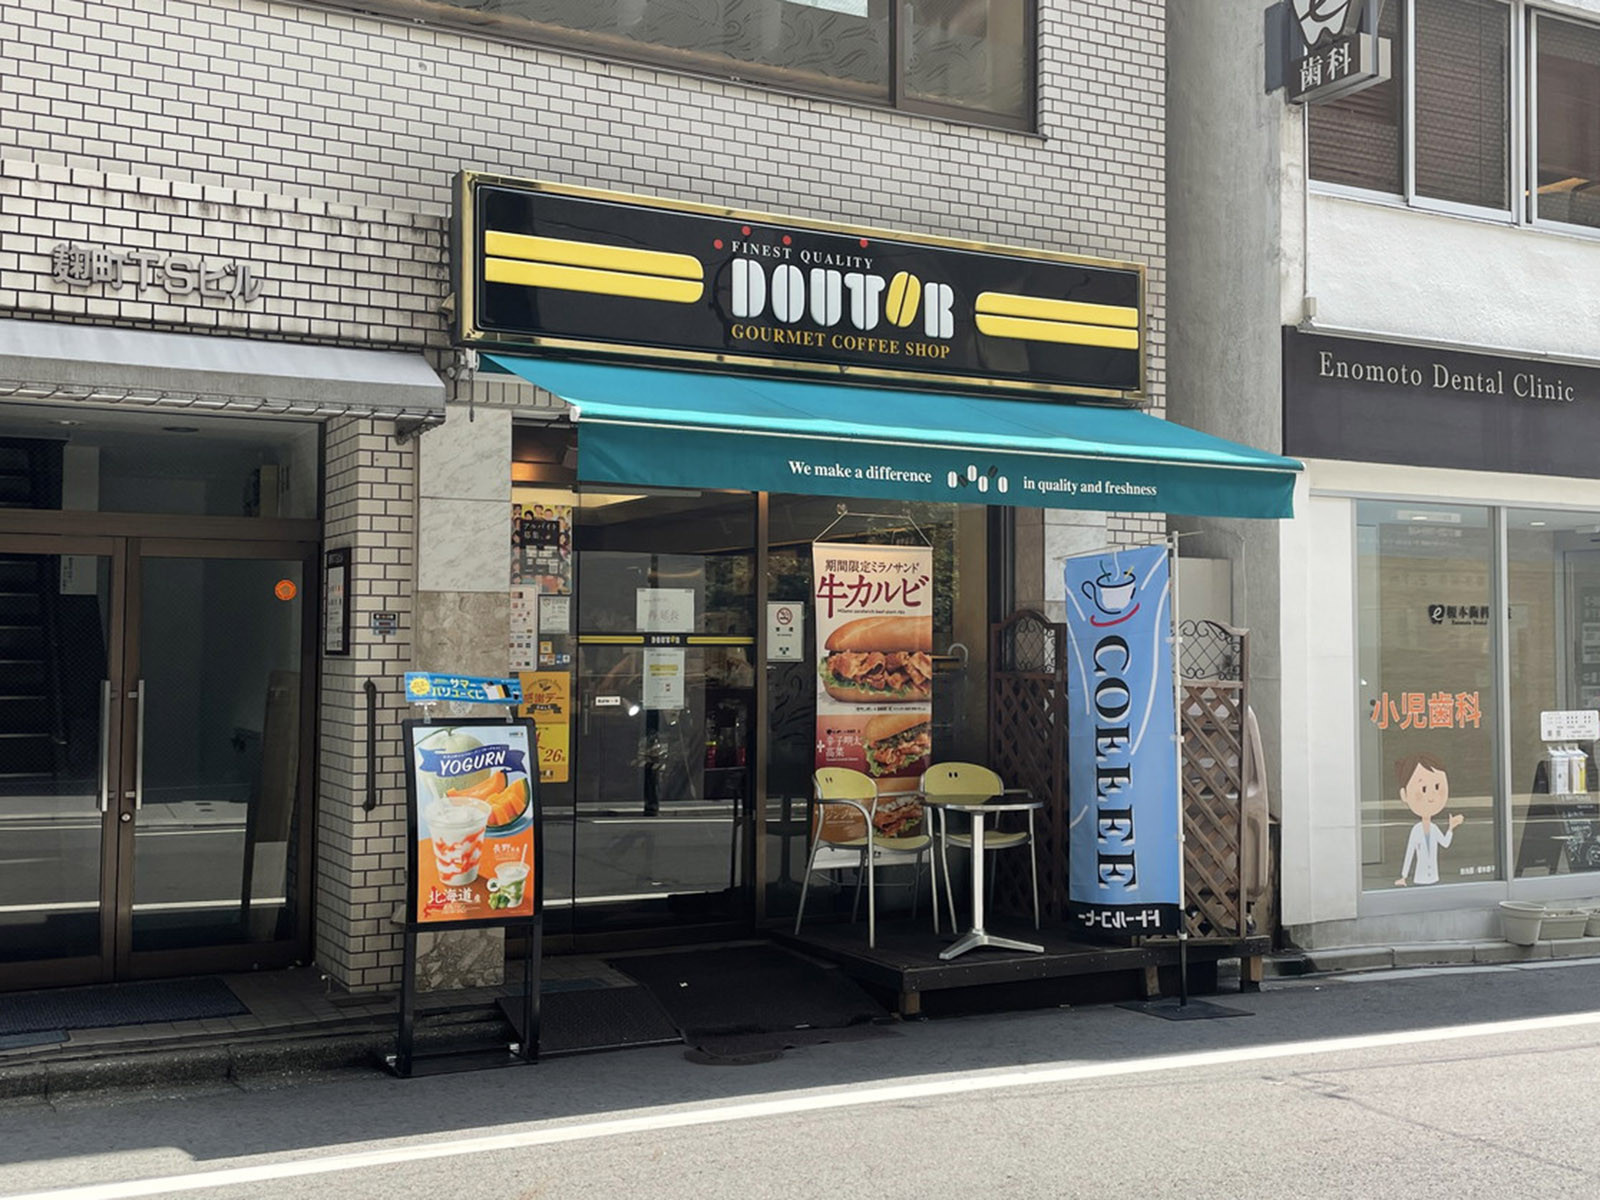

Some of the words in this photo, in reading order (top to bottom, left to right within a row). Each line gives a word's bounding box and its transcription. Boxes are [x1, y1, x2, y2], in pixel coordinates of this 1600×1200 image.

[1300, 42, 1352, 91] 歯科
[731, 240, 792, 260] FINEST
[800, 250, 873, 269] QUALITY
[731, 258, 955, 339] DOUTOR
[731, 324, 826, 348] GOURMET
[831, 334, 900, 354] COFFEE
[905, 342, 950, 359] SHOP
[1319, 351, 1423, 386] Enomoto
[1433, 363, 1504, 395] Dental
[1513, 373, 1575, 402] Clinic
[788, 460, 812, 476] We
[814, 464, 853, 479] make
[855, 470, 863, 479] a
[865, 467, 932, 483] difference
[1023, 476, 1037, 490] in
[1038, 478, 1077, 495] quality
[1080, 480, 1102, 493] and
[1105, 481, 1157, 496] freshness
[825, 559, 920, 574] 期間限定ミラノサンド
[816, 573, 930, 618] 牛カルビ
[450, 678, 477, 688] サマー
[1370, 691, 1482, 729] 小児歯科
[440, 750, 506, 776] YOGURN
[543, 748, 563, 762] 26
